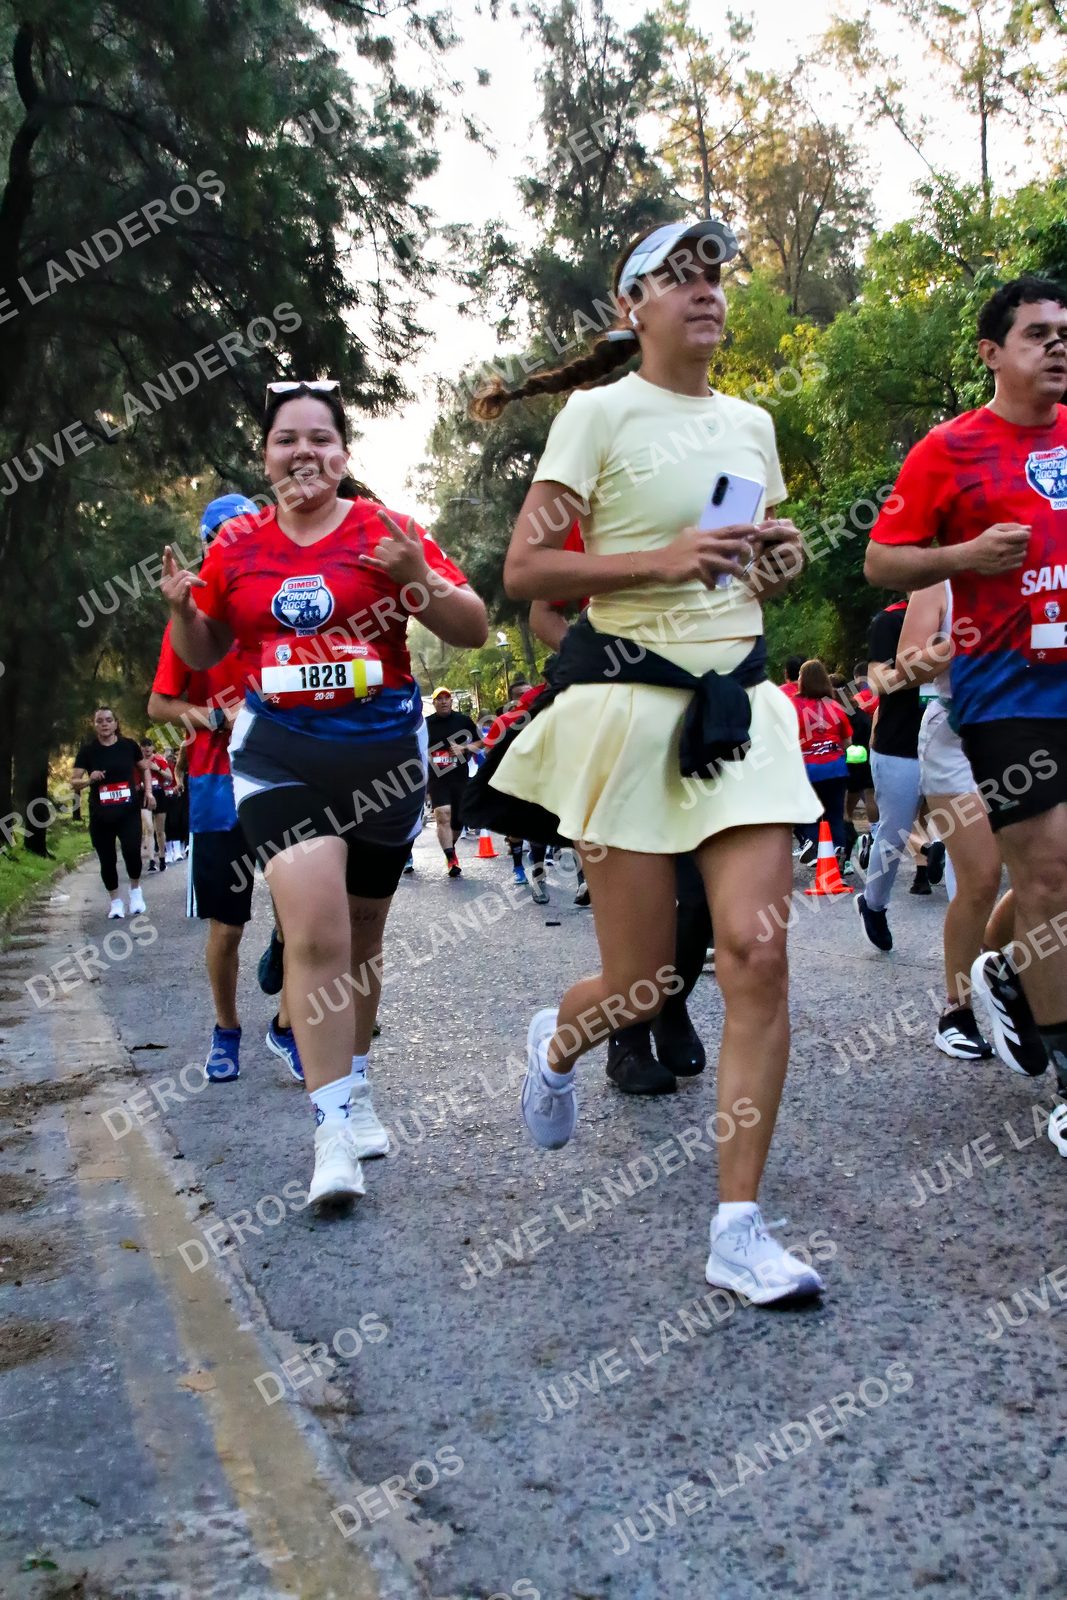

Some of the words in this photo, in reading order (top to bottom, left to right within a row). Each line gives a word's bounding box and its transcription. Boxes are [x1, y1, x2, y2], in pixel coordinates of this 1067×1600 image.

[1053, 500, 1067, 508] 202
[287, 581, 319, 589] BIMBO
[287, 591, 318, 601] Global
[281, 600, 307, 610] Race
[299, 664, 347, 688] 1828
